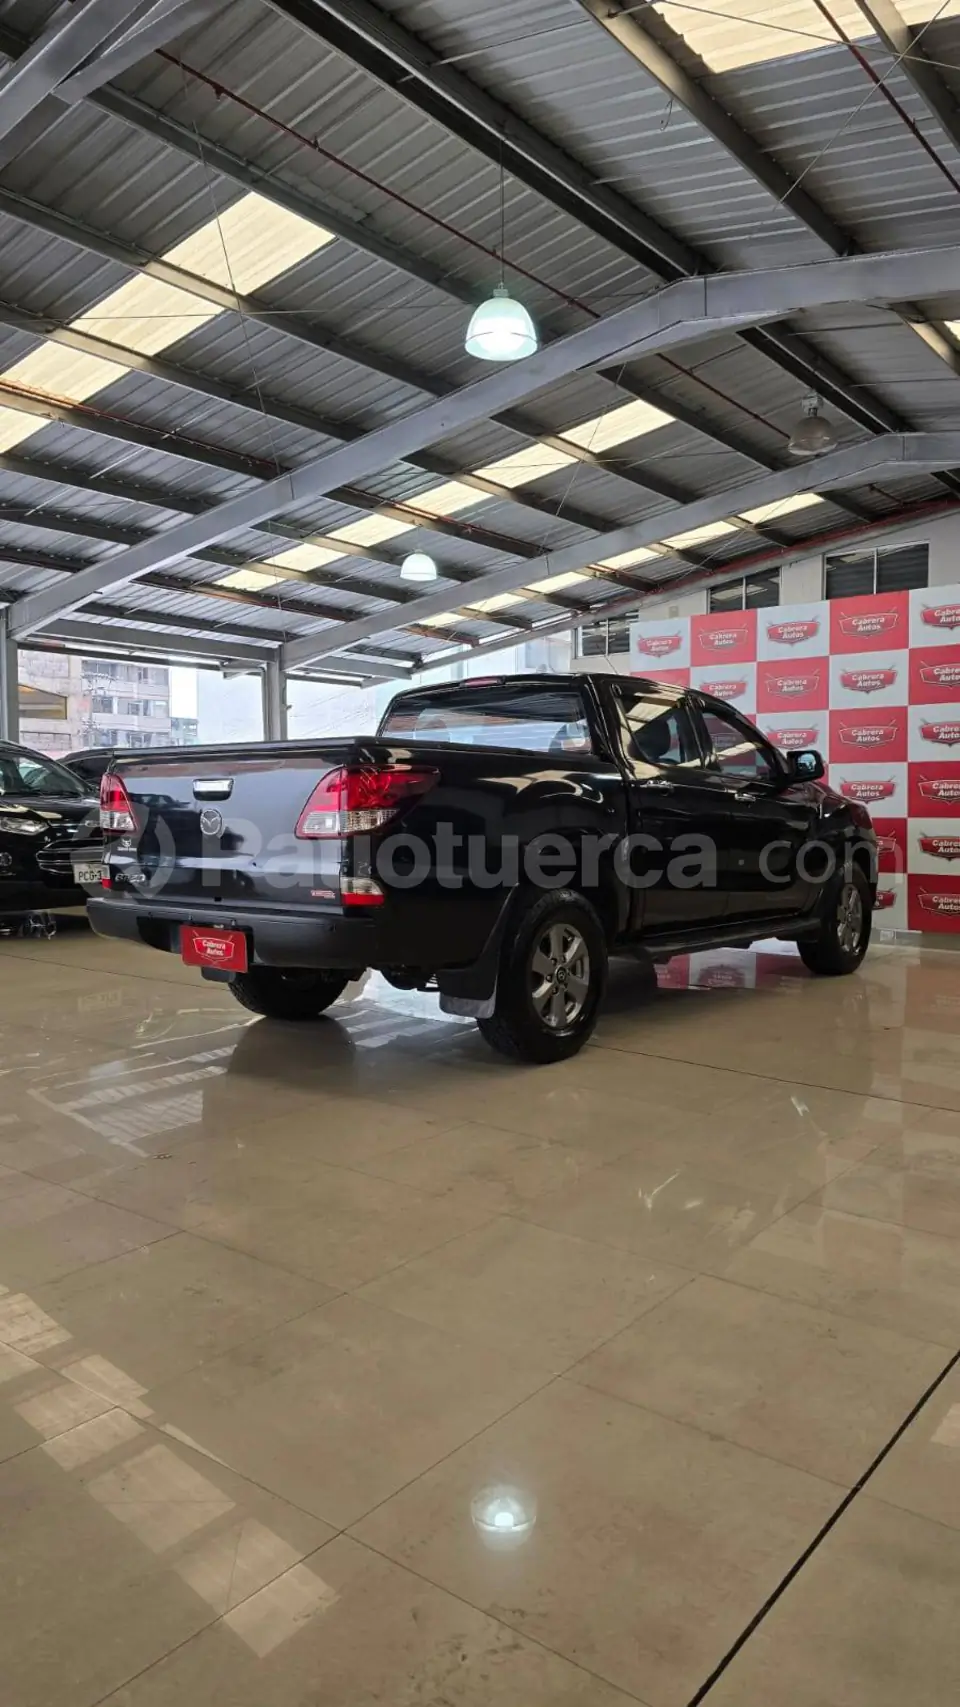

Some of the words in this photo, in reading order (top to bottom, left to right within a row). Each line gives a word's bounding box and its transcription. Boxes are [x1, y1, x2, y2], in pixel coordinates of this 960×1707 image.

[934, 608, 960, 617] Cabre
[852, 616, 885, 626] Cabrera
[939, 614, 960, 623] Auto
[778, 625, 808, 634] Cabrera
[857, 624, 881, 632] Autos
[709, 632, 737, 640] Cabrera
[782, 631, 804, 640] Autos
[934, 667, 960, 675] Cabre
[852, 673, 885, 681] Cabrera
[939, 674, 960, 682] Auto
[777, 678, 807, 686] Cabrera
[856, 679, 881, 688] Autos
[851, 728, 884, 737] Cabrera
[933, 725, 960, 733] Cabre
[777, 731, 807, 739] Cabrera
[856, 735, 880, 743] Autos
[938, 732, 960, 740] Auto
[781, 737, 803, 745] Autos
[851, 783, 884, 791] Cabrera
[932, 782, 960, 790] Cabre
[856, 789, 880, 797] Autos
[938, 789, 960, 797] Auto
[932, 839, 960, 847] Cabre
[938, 846, 960, 854] Auto
[932, 895, 960, 903] Cabre
[202, 940, 226, 950] Cabrera
